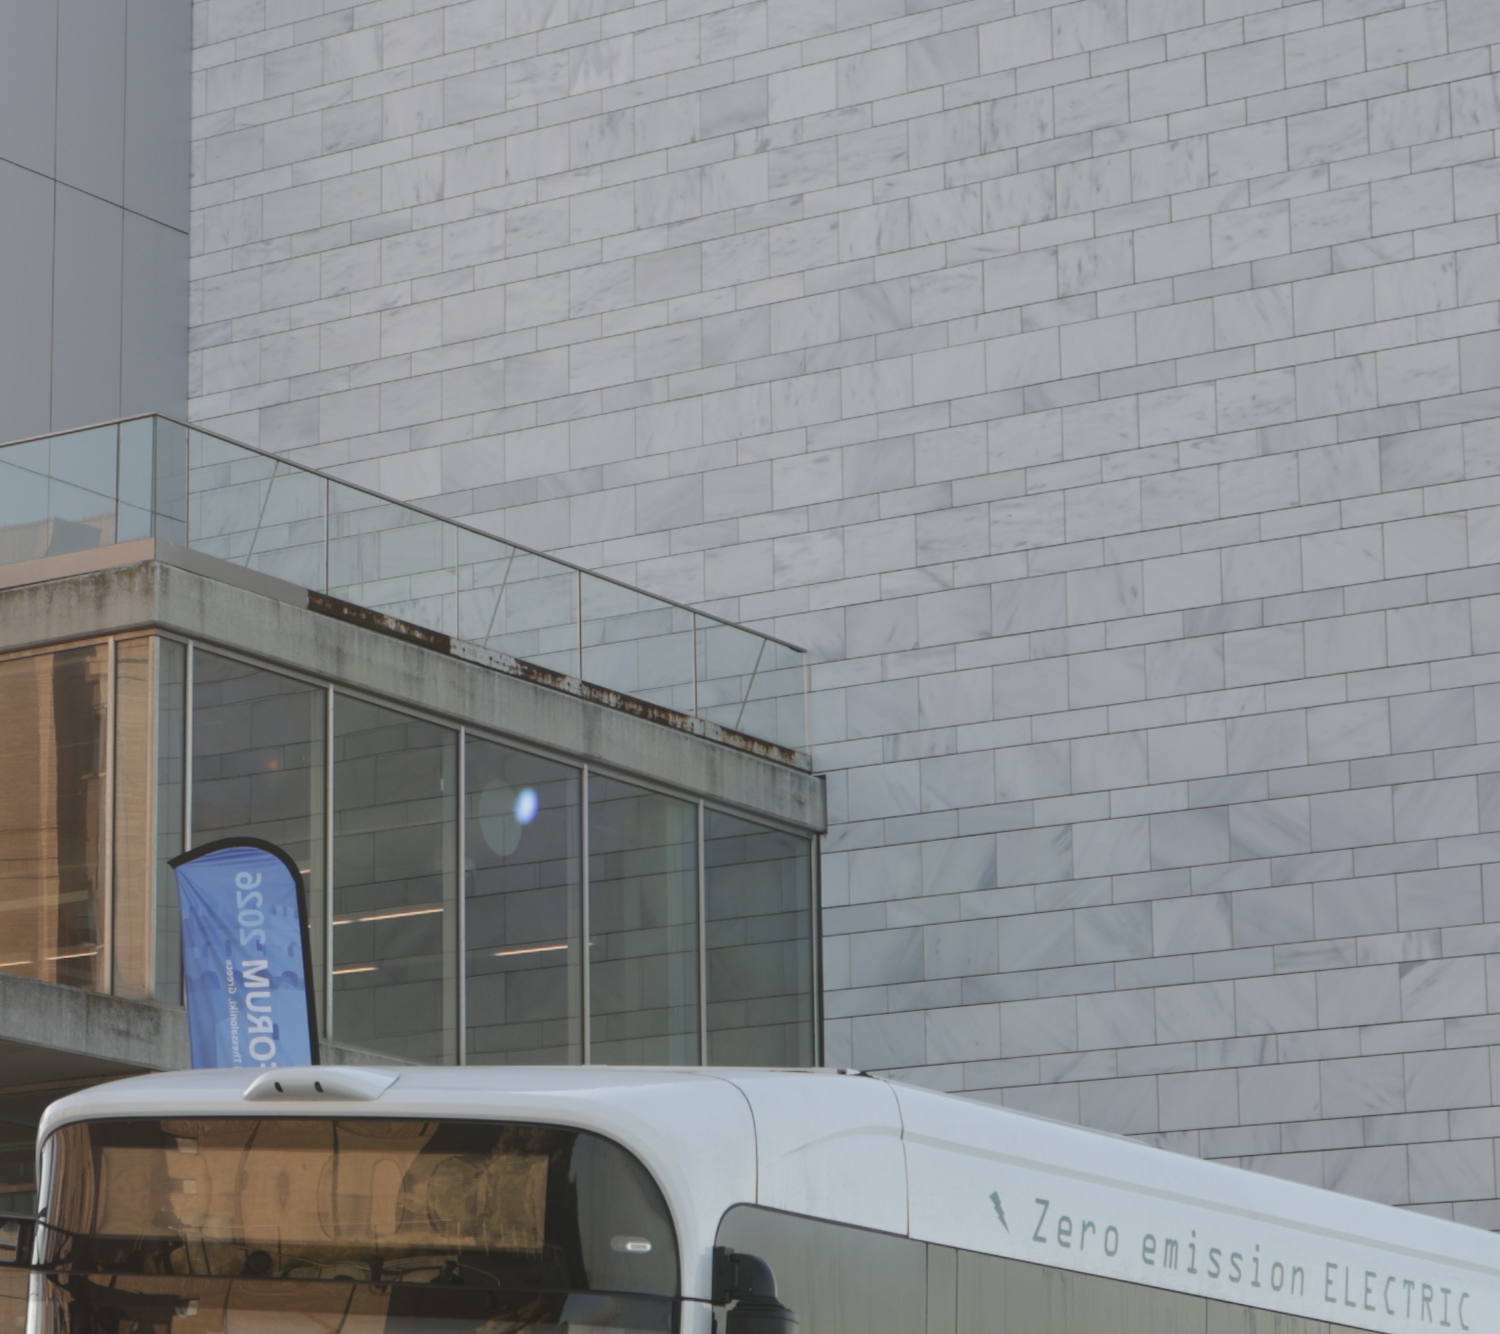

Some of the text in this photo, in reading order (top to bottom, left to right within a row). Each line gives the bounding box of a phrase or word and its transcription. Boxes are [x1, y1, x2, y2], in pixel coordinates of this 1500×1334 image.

[1032, 1197, 1470, 1331] Zero emission ELECTRIC
